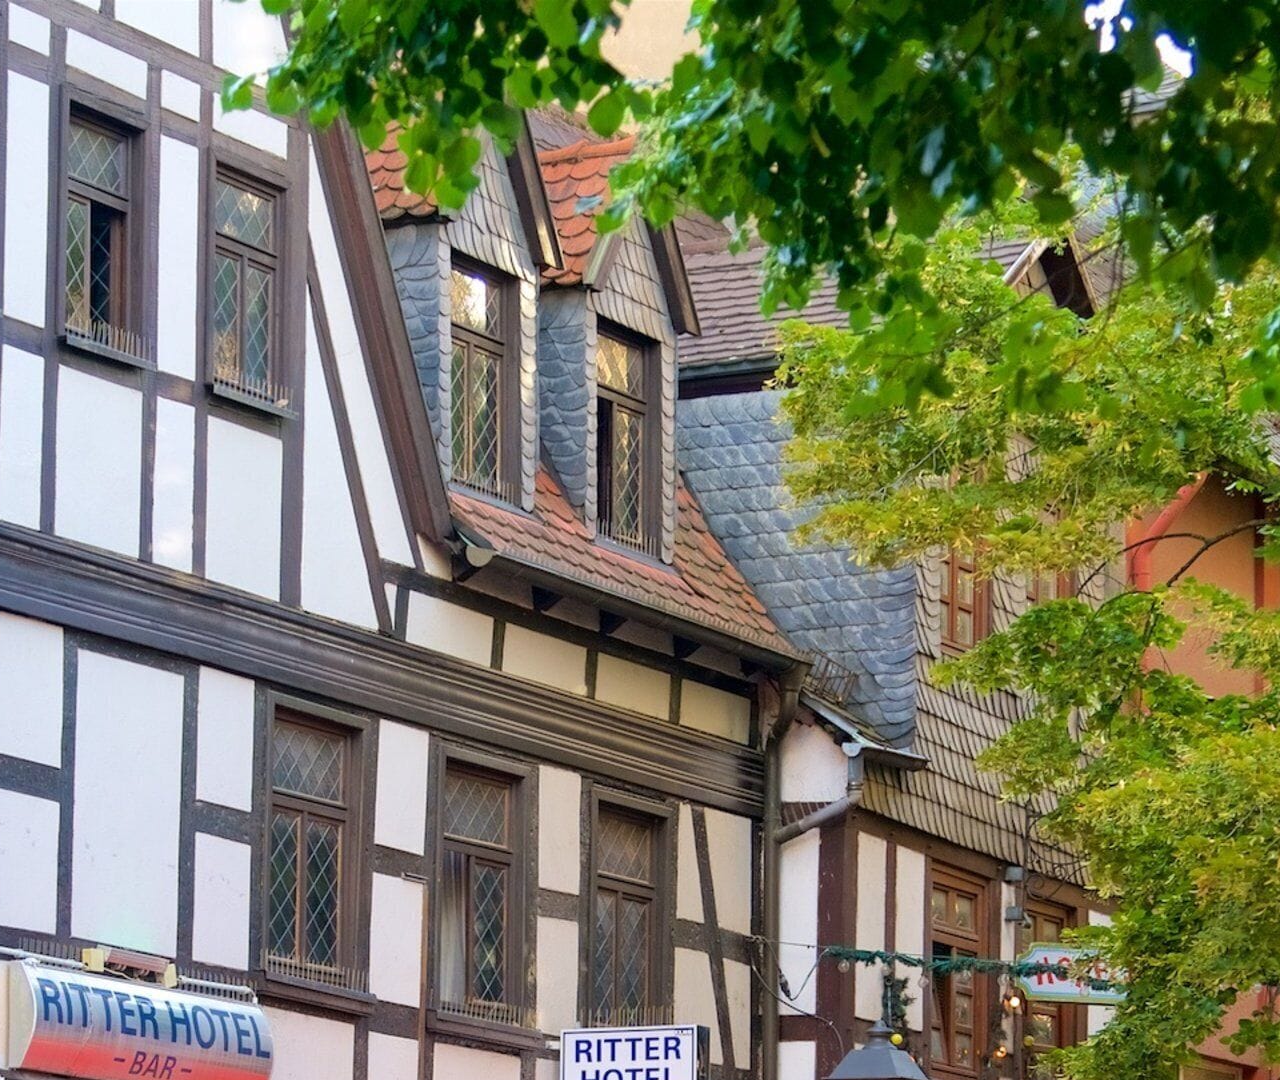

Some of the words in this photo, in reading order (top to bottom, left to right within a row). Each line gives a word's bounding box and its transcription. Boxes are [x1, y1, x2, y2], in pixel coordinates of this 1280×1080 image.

[36, 977, 160, 1041] RITTER
[165, 1000, 271, 1059] HOTEL
[575, 1036, 681, 1063] RITTER
